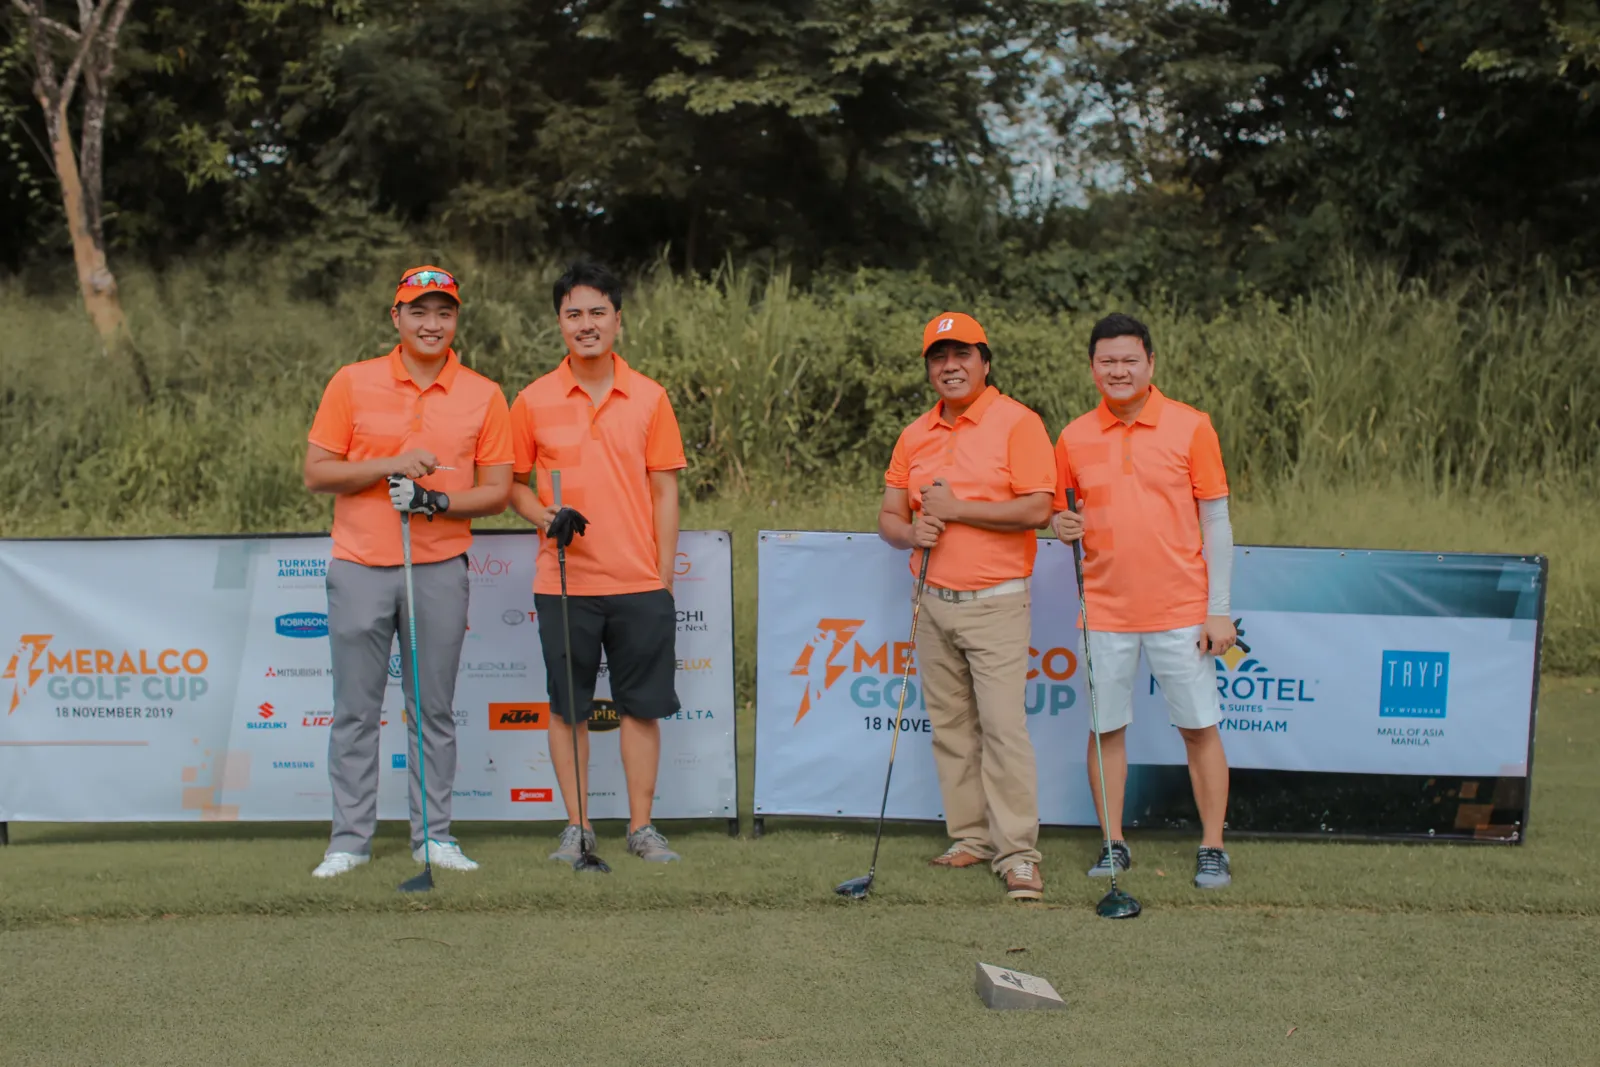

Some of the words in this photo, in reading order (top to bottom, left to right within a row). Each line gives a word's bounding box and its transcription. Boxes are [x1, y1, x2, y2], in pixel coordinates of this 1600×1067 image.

[278, 559, 326, 567] TURKISH
[468, 553, 513, 575] AVOY
[278, 569, 327, 577] AIRLINES
[686, 624, 708, 632] Next
[47, 649, 208, 674] MERALCO
[467, 662, 527, 670] LEXUS
[277, 669, 322, 677] MITSUBISHI
[1388, 661, 1443, 688] TRYP
[47, 676, 131, 700] GOLF
[142, 676, 208, 700] CUP
[850, 676, 926, 711] GO
[1025, 683, 1076, 716] UP
[56, 707, 69, 718] 18
[72, 707, 142, 719] NOVEMBER
[145, 707, 174, 718] 2019
[1228, 704, 1263, 712] SUITES
[500, 710, 539, 723] KTM
[864, 716, 882, 731] 18
[887, 717, 931, 732] NOVE
[1218, 718, 1287, 732] YNDHAM
[1377, 728, 1404, 736] MALL
[1407, 728, 1420, 736] OF
[1422, 729, 1444, 737] ASIA
[1391, 738, 1430, 746] MANILA
